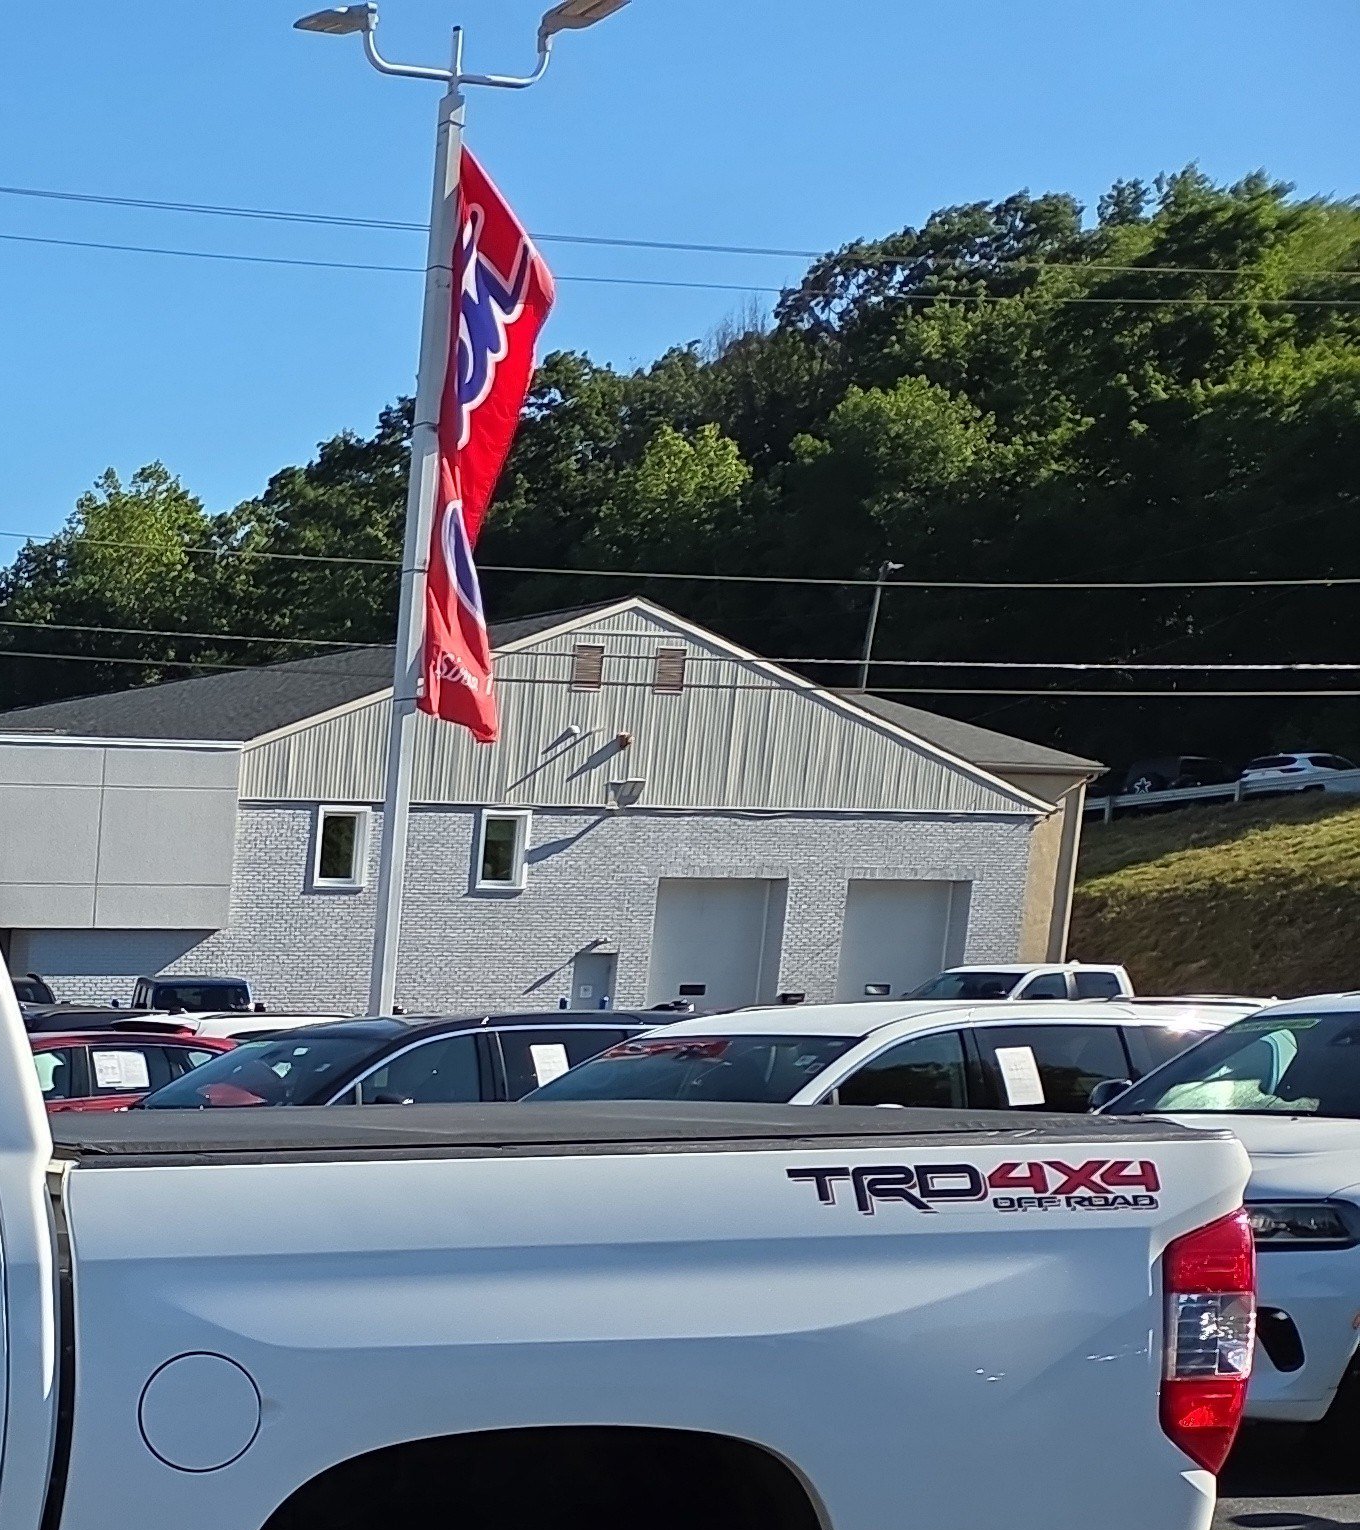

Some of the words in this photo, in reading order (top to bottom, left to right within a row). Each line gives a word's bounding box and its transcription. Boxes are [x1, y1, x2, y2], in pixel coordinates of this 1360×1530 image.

[786, 1163, 989, 1216] TRD
[992, 1196, 1063, 1213] OFF
[1065, 1194, 1160, 1212] ROAD
